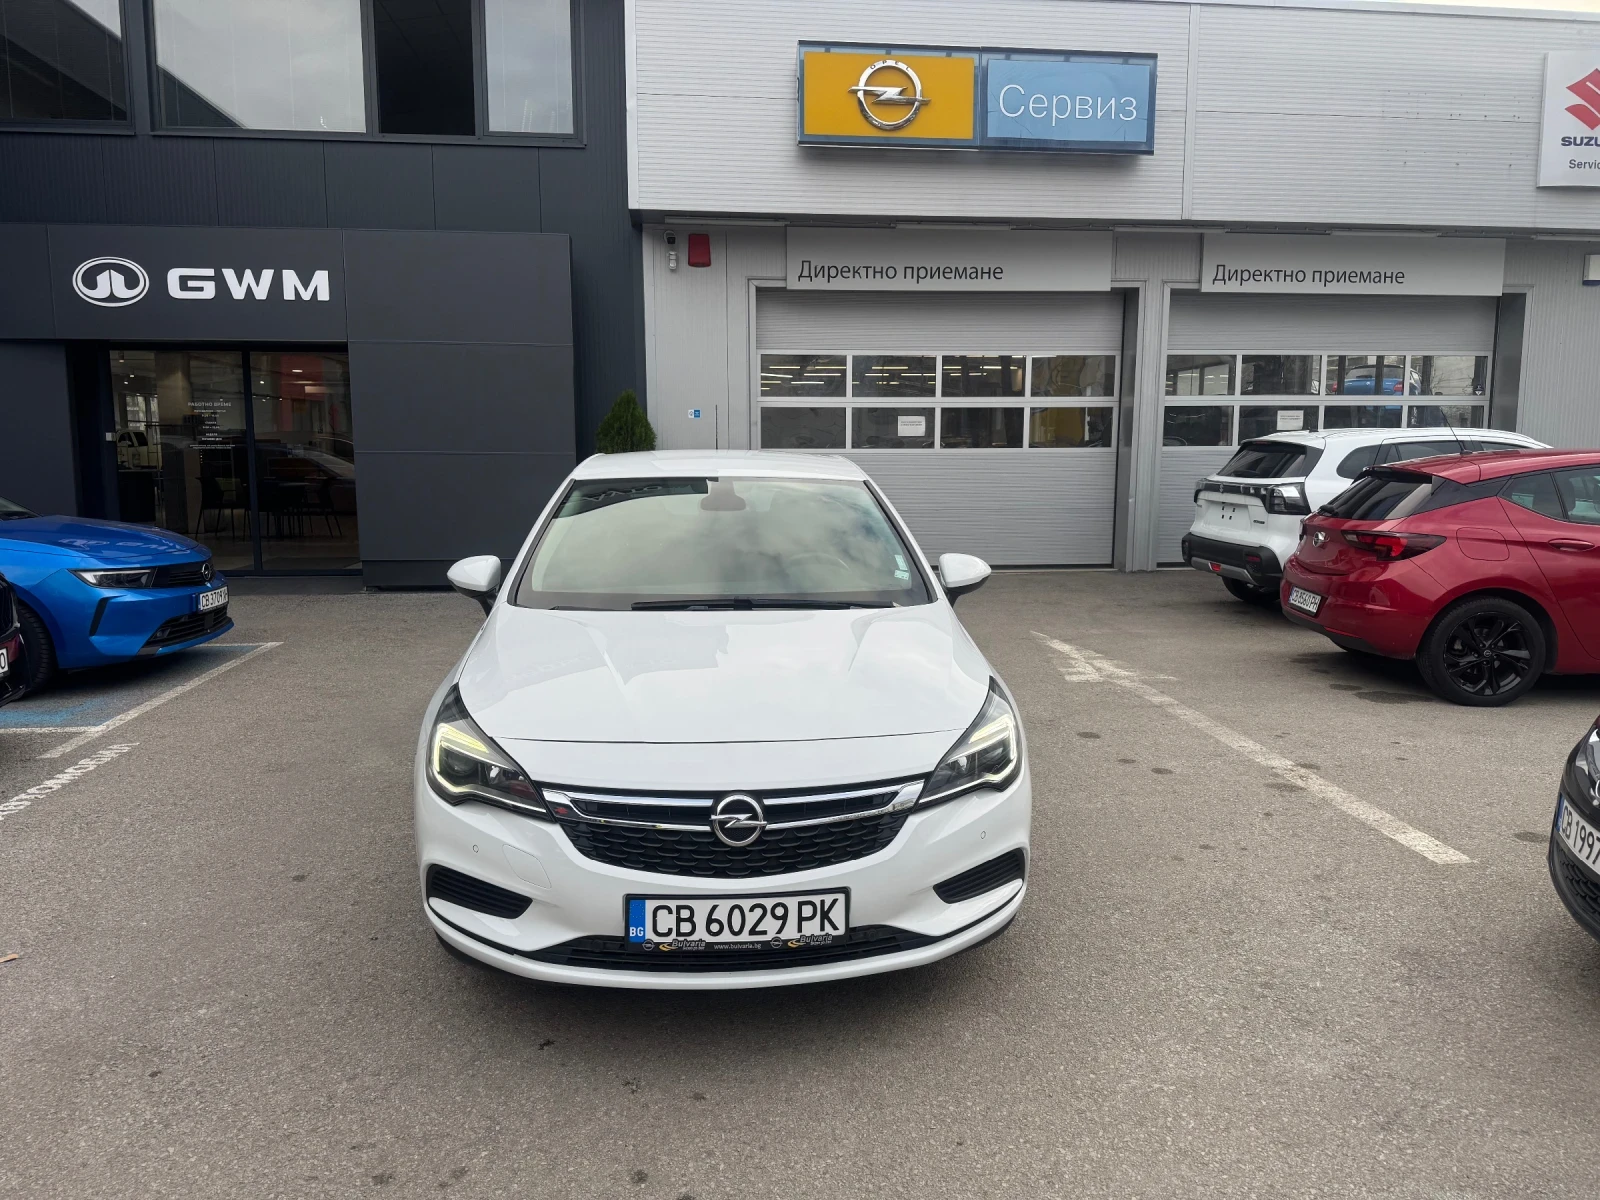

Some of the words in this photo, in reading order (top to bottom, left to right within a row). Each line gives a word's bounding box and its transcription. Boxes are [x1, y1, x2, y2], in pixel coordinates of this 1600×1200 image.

[869, 60, 910, 72] OPEL
[999, 84, 1137, 126] Сервиз
[798, 260, 897, 283] Директно
[903, 265, 1004, 284] приемане
[1212, 264, 1306, 286] Директно
[1311, 269, 1405, 287] приемане
[166, 267, 330, 301] GWM
[629, 926, 645, 937] BG
[652, 904, 697, 938] CB
[705, 901, 790, 937] 6029
[797, 897, 840, 934] PK
[671, 939, 706, 948] Bulvaria
[713, 942, 762, 950] www.bulvaria.bg
[799, 933, 833, 943] Bulvaria
